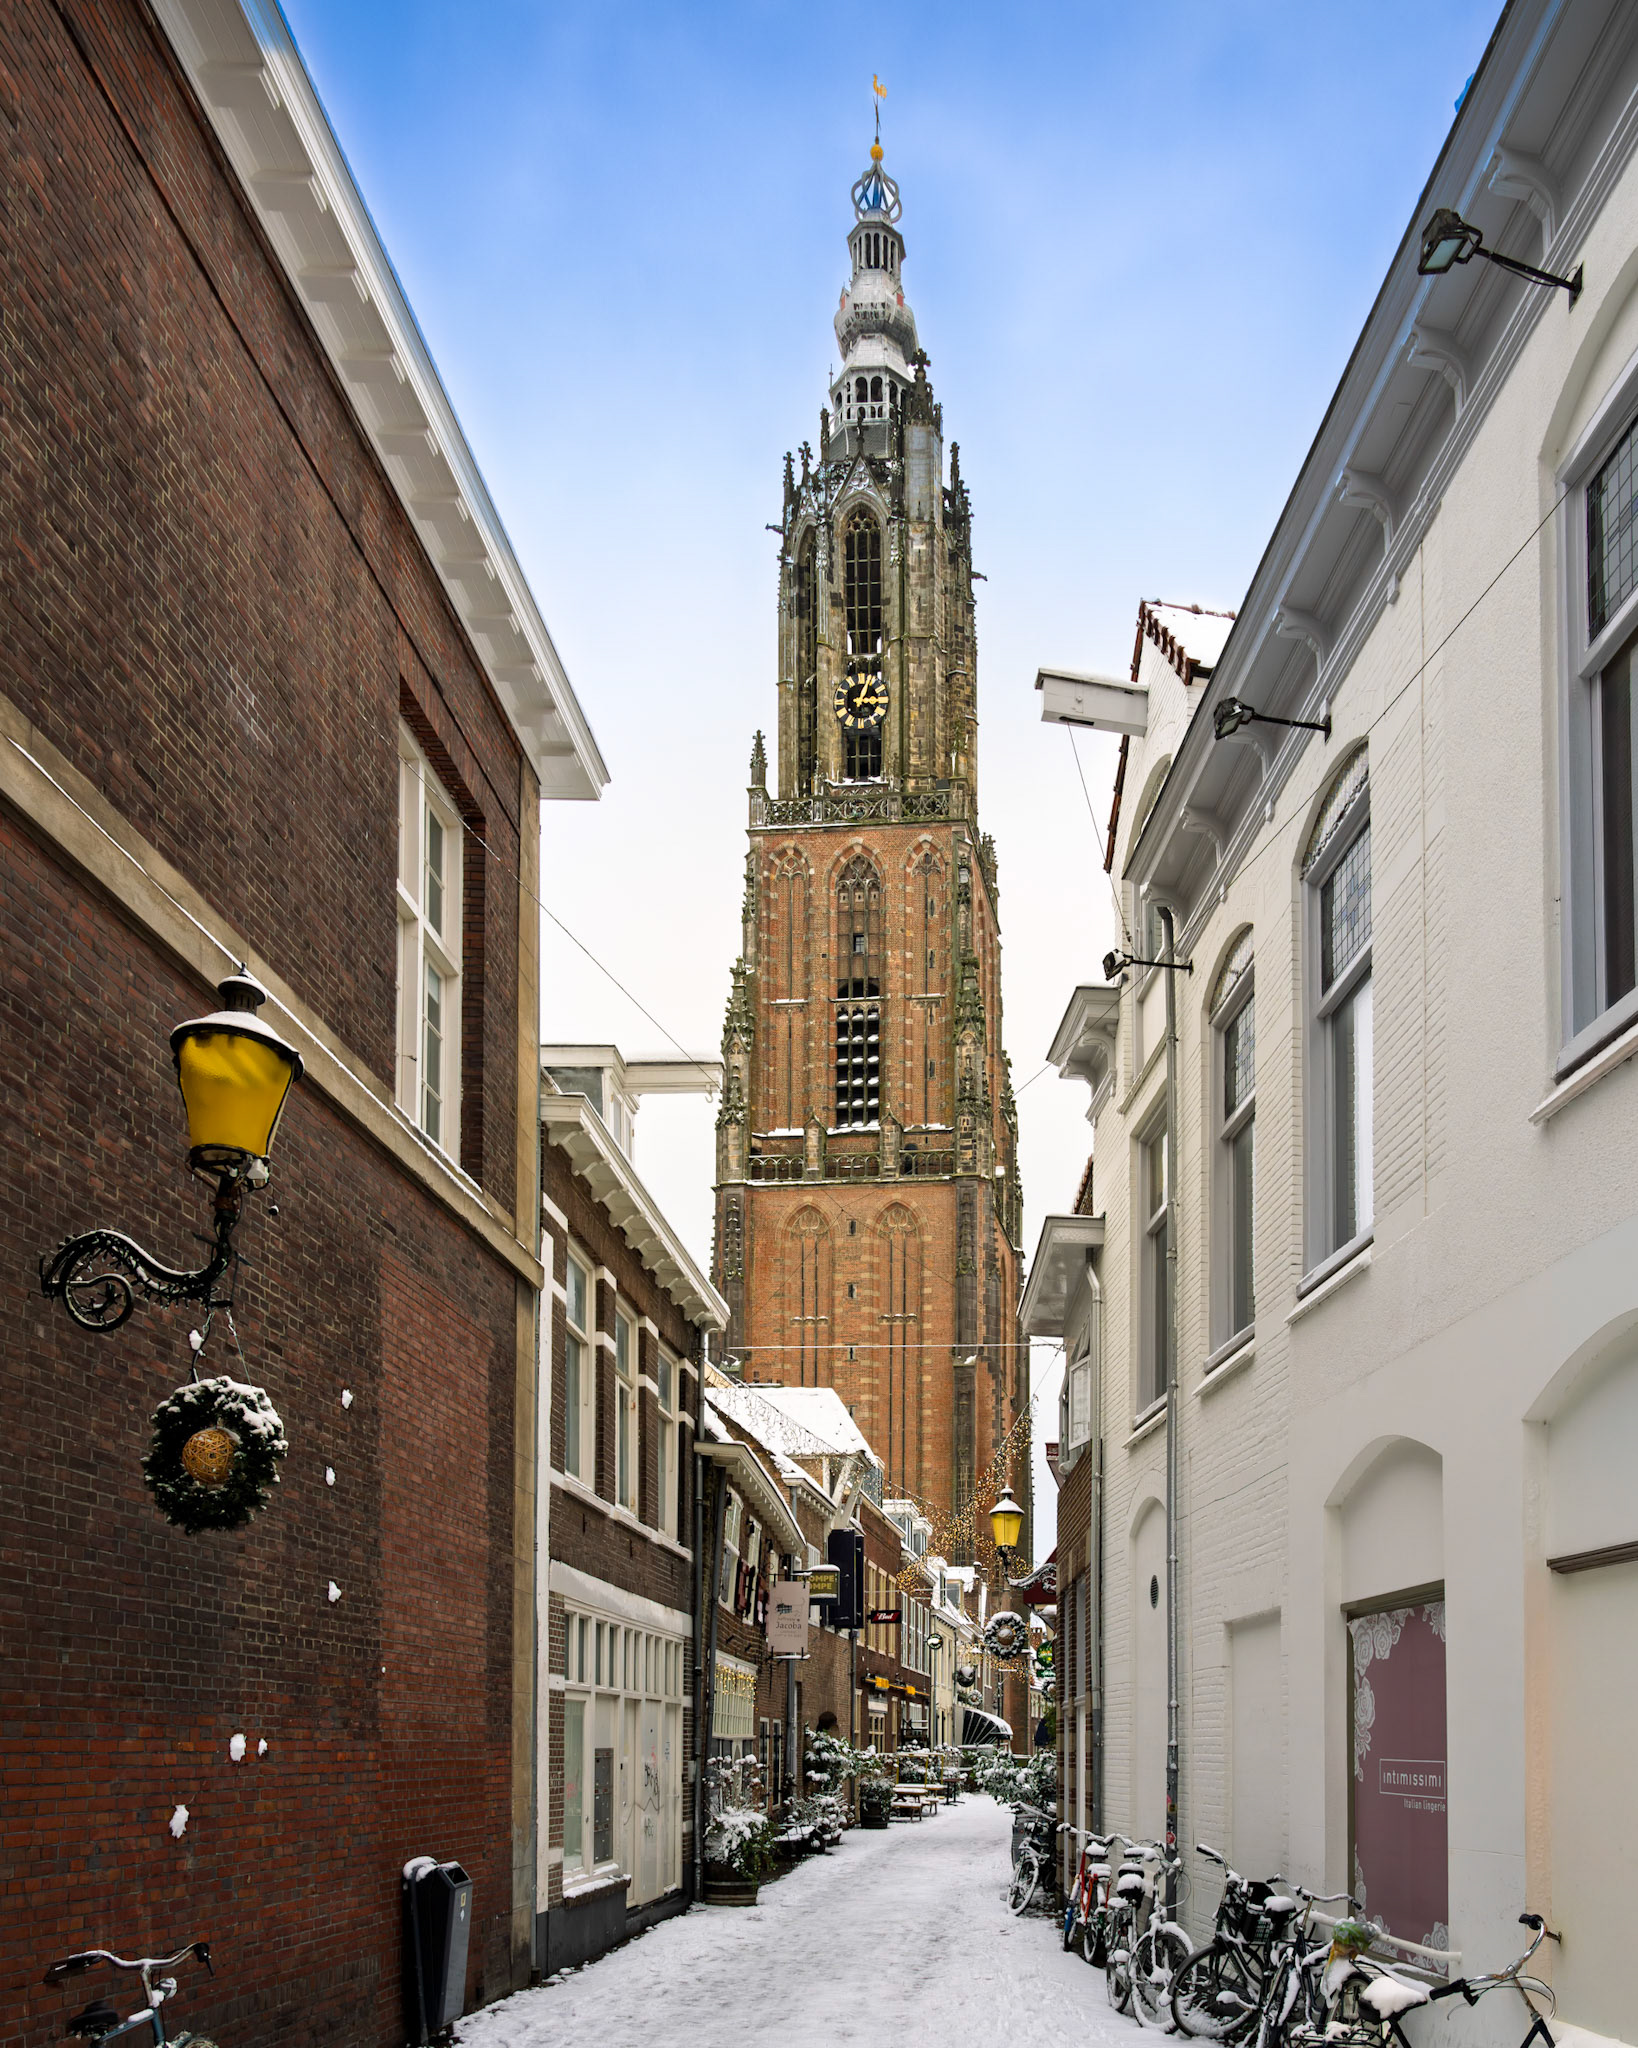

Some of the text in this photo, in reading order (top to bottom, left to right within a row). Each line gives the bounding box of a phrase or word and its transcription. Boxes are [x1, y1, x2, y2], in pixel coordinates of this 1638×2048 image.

[877, 1612, 894, 1620] Bud
[775, 1621, 802, 1630] Jacoba
[1383, 1770, 1442, 1788] intimissimi
[1403, 1798, 1446, 1814] Italian lingerie
